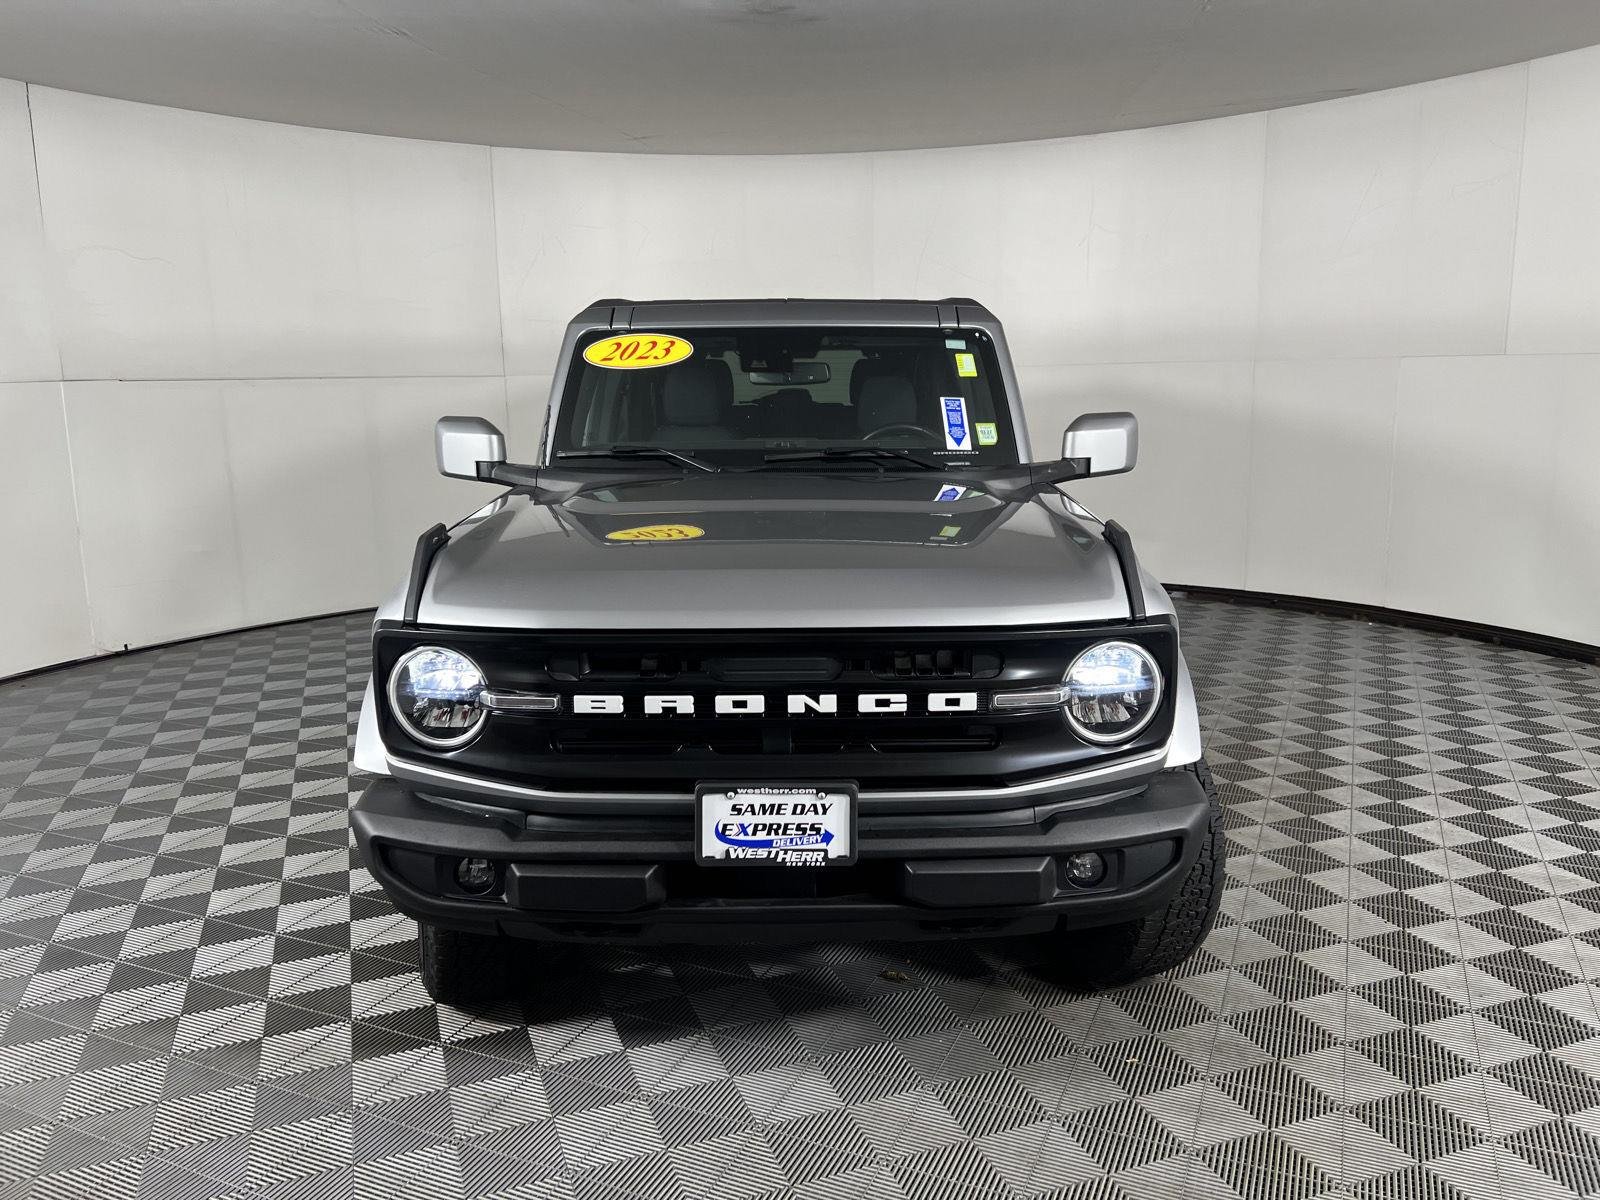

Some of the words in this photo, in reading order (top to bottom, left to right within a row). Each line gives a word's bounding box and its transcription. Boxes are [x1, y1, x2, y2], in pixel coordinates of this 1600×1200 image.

[600, 340, 676, 361] 2023
[573, 692, 978, 714] BRONCO
[730, 803, 788, 816] SAME
[791, 803, 833, 816] DAY
[721, 822, 823, 836] EXPRESS
[773, 835, 824, 847] DELIVERY
